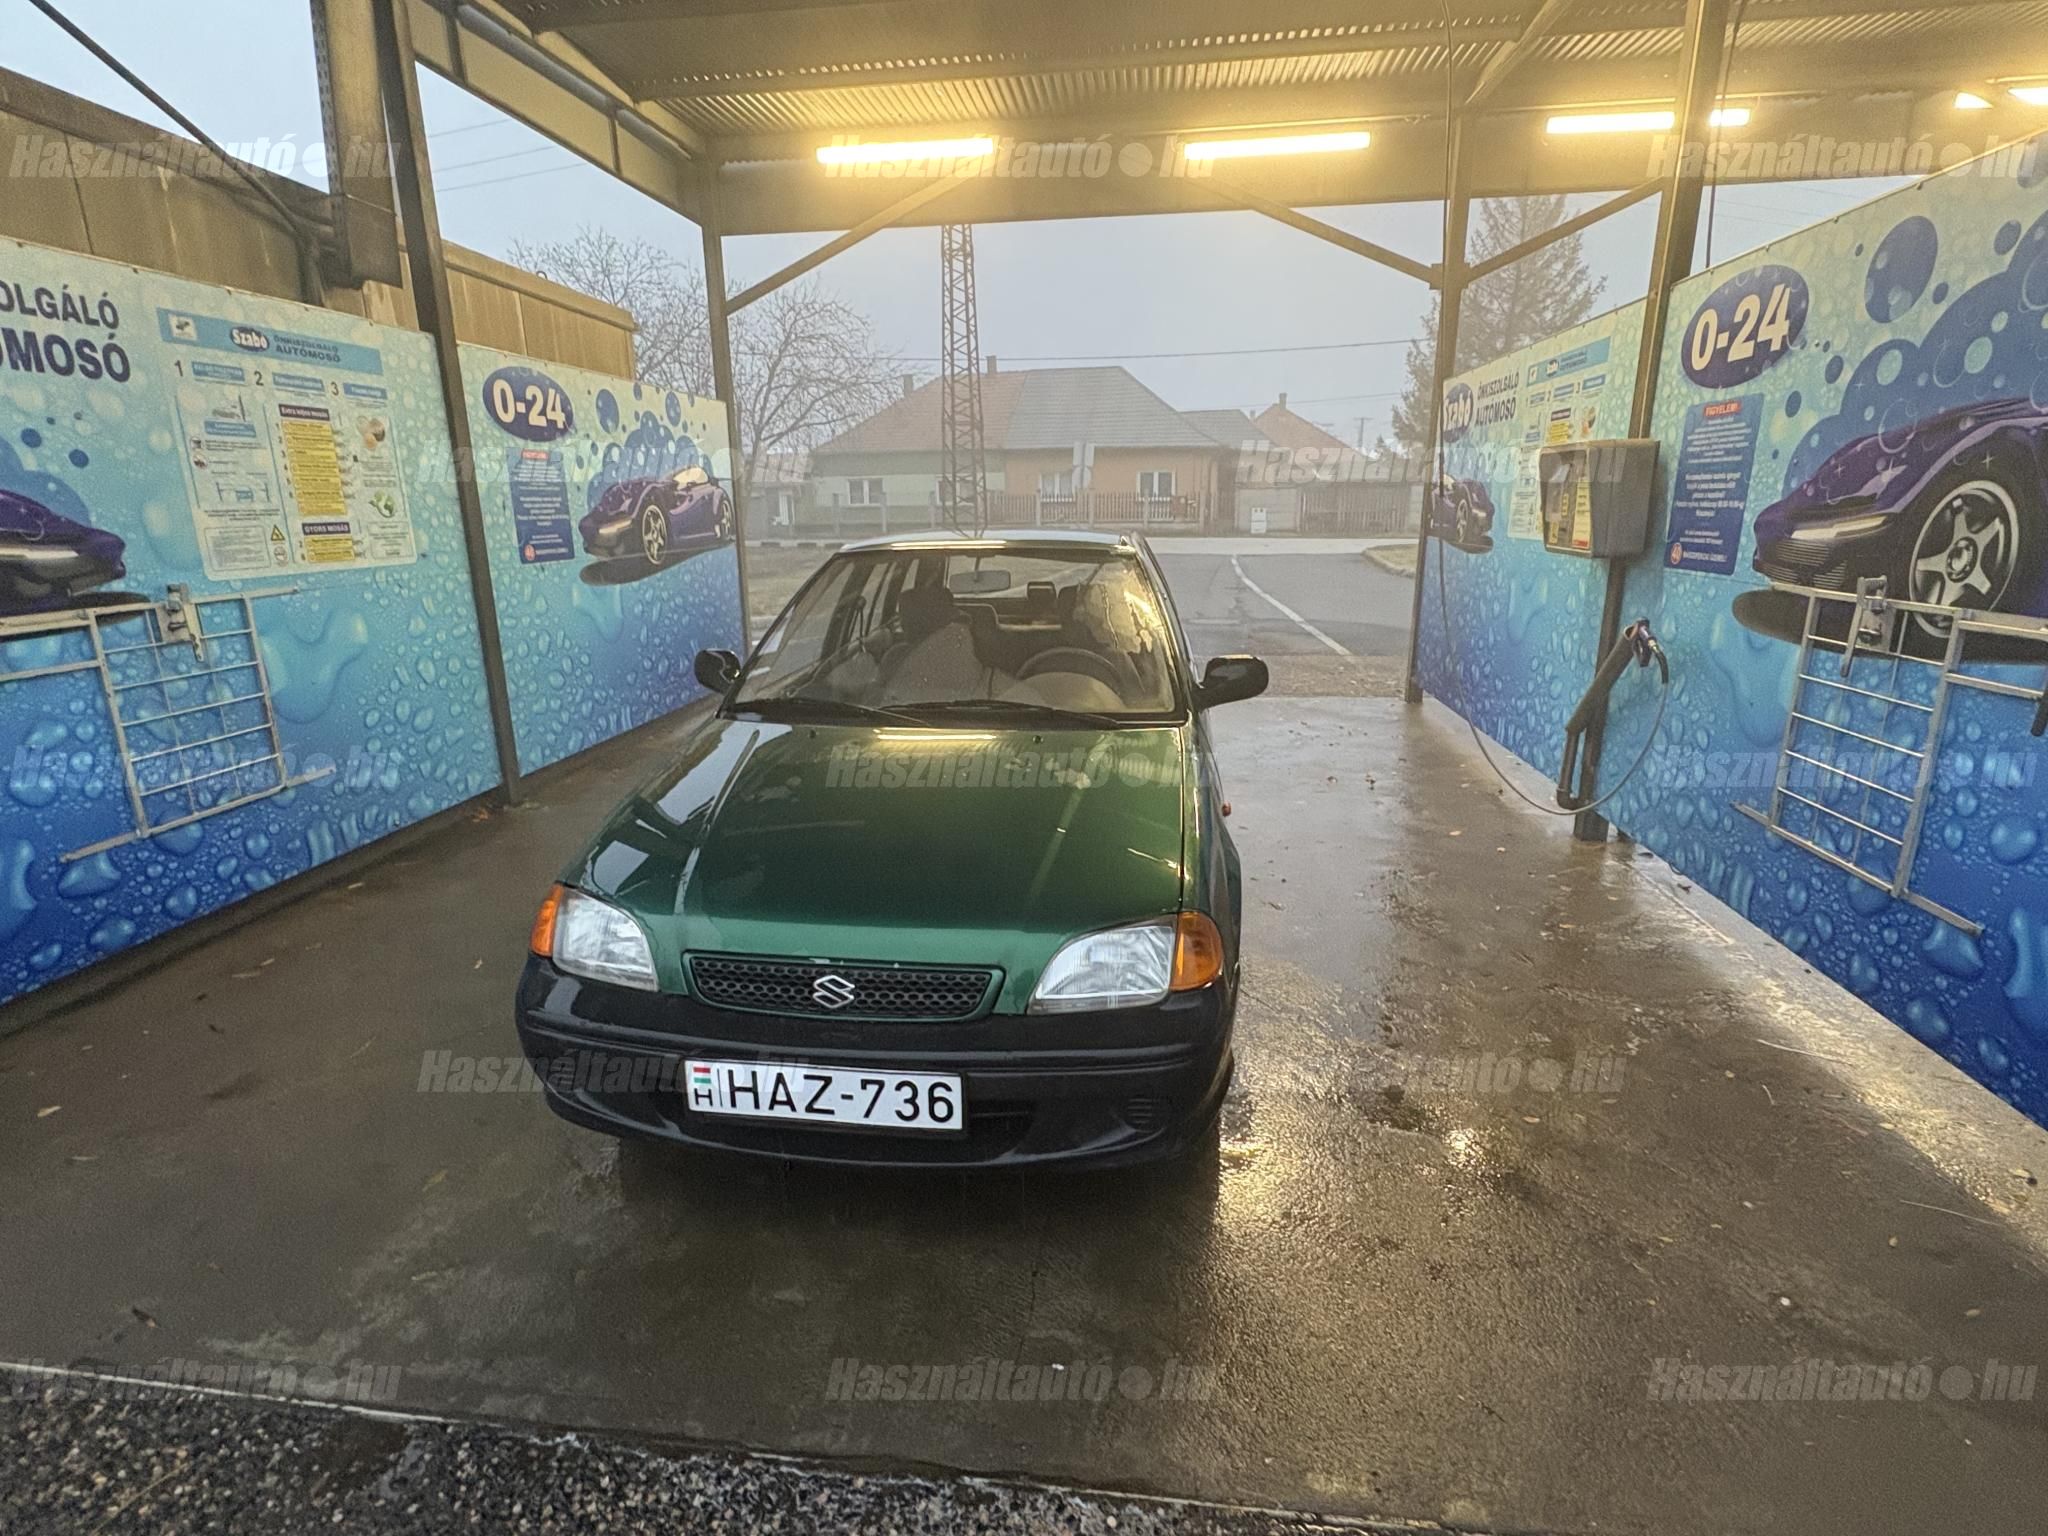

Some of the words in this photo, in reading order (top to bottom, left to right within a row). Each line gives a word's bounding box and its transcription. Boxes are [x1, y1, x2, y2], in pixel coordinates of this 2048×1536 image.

[1691, 283, 1791, 371] 0-24
[0, 327, 131, 383] MOSÓ
[254, 370, 264, 386] 2
[330, 381, 339, 396] 3
[492, 378, 566, 429] 0-24
[727, 1068, 954, 1123] HAZ-736
